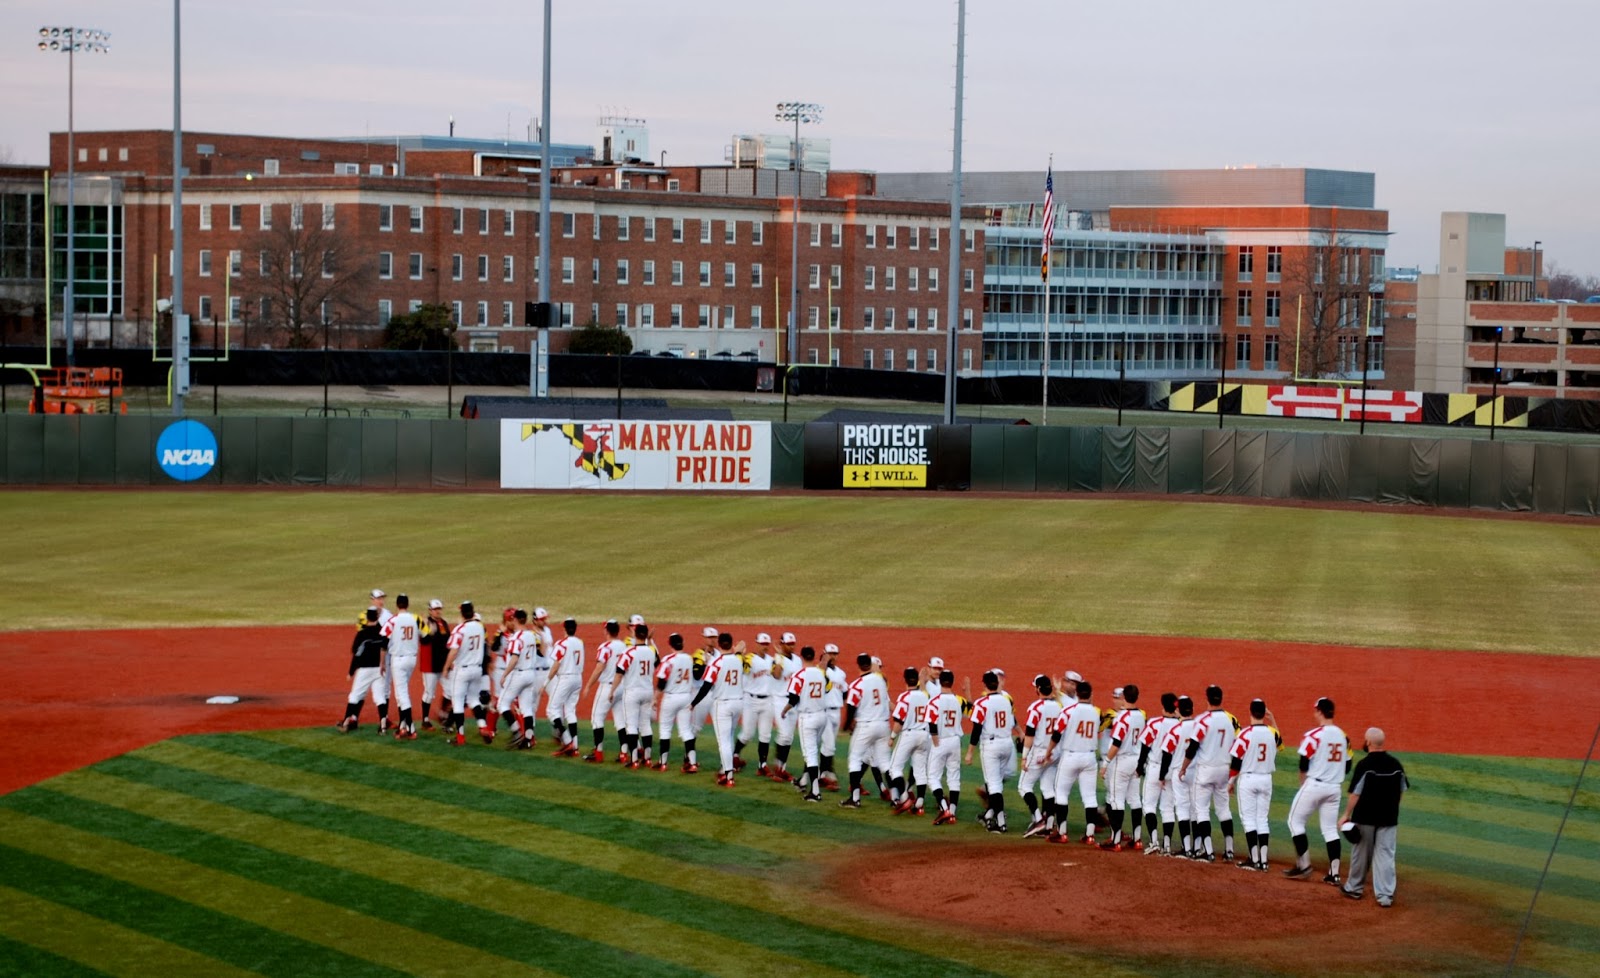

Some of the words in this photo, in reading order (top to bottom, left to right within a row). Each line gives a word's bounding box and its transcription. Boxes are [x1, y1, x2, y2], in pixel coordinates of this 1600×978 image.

[618, 423, 752, 451] MARYLAND
[162, 449, 215, 466] NCAA
[843, 448, 875, 465] THIS
[879, 448, 931, 465] HOUSE.
[676, 456, 751, 483] PRIDE
[874, 470, 880, 481] I
[401, 626, 414, 641] 30
[468, 635, 481, 651] 37
[573, 650, 581, 666] 7
[639, 659, 651, 677] 31
[676, 668, 690, 684] 34
[725, 669, 739, 686] 43
[809, 682, 822, 698] 23
[943, 710, 956, 728] 35
[994, 711, 1007, 729] 18
[1076, 721, 1094, 739] 40
[1218, 729, 1226, 748] 7
[1257, 743, 1267, 762] 3
[1327, 743, 1342, 762] 36
